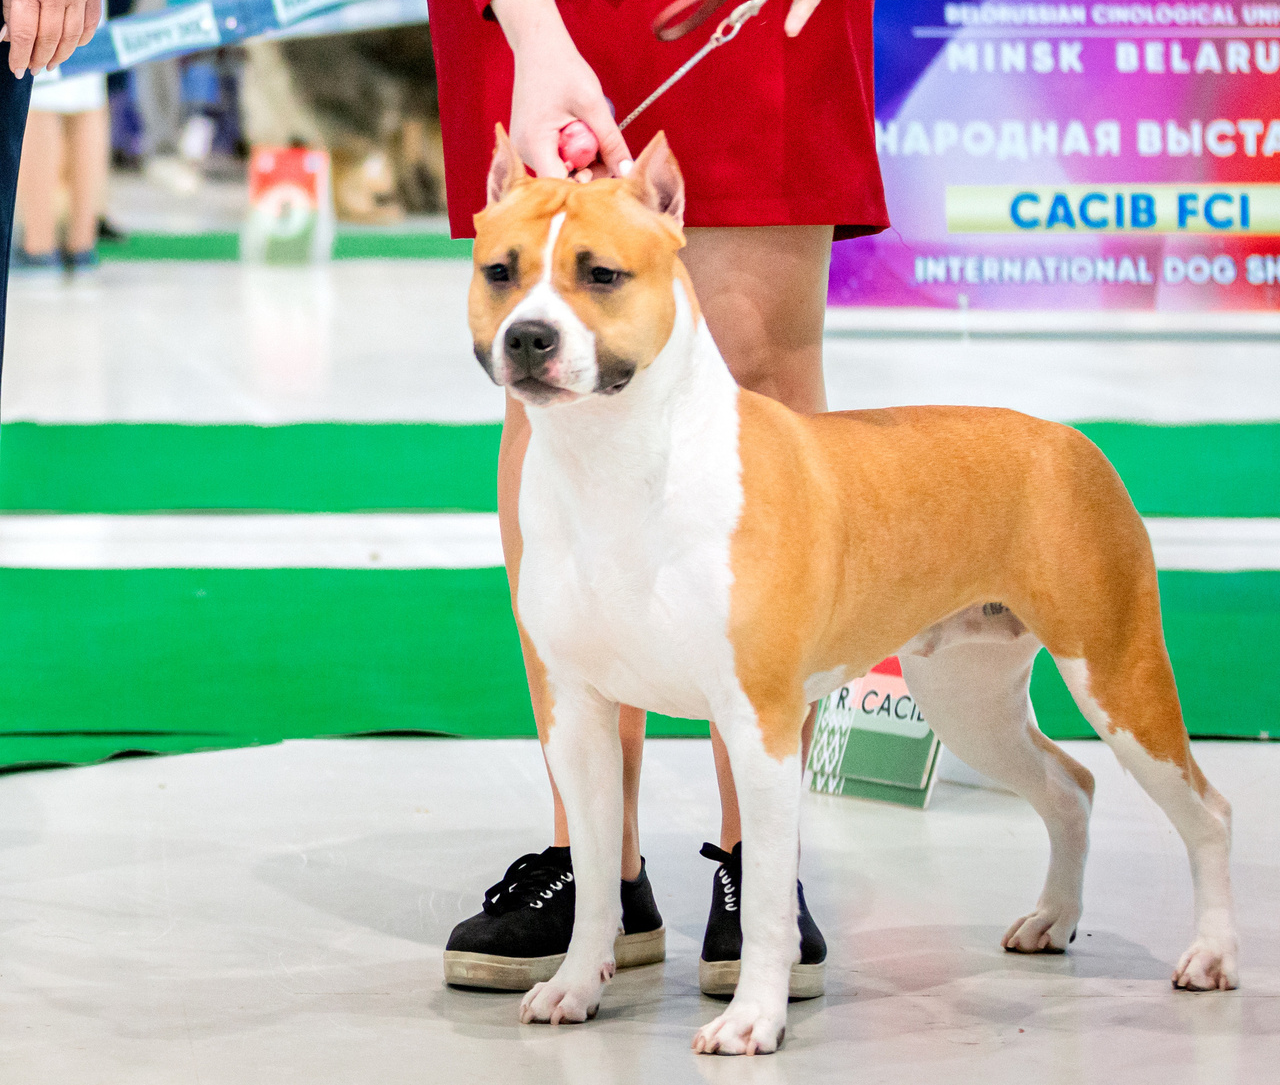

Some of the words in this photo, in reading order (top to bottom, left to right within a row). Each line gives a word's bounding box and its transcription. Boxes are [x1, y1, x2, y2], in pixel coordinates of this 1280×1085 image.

[948, 40, 1084, 74] MINSK
[875, 120, 1120, 161] НАРОДНАЯ
[1010, 192, 1157, 230] CACIB
[1177, 192, 1250, 230] FCI
[915, 256, 1153, 285] INTERNATIONAL
[1163, 255, 1237, 285] DOG
[837, 687, 852, 712] R.
